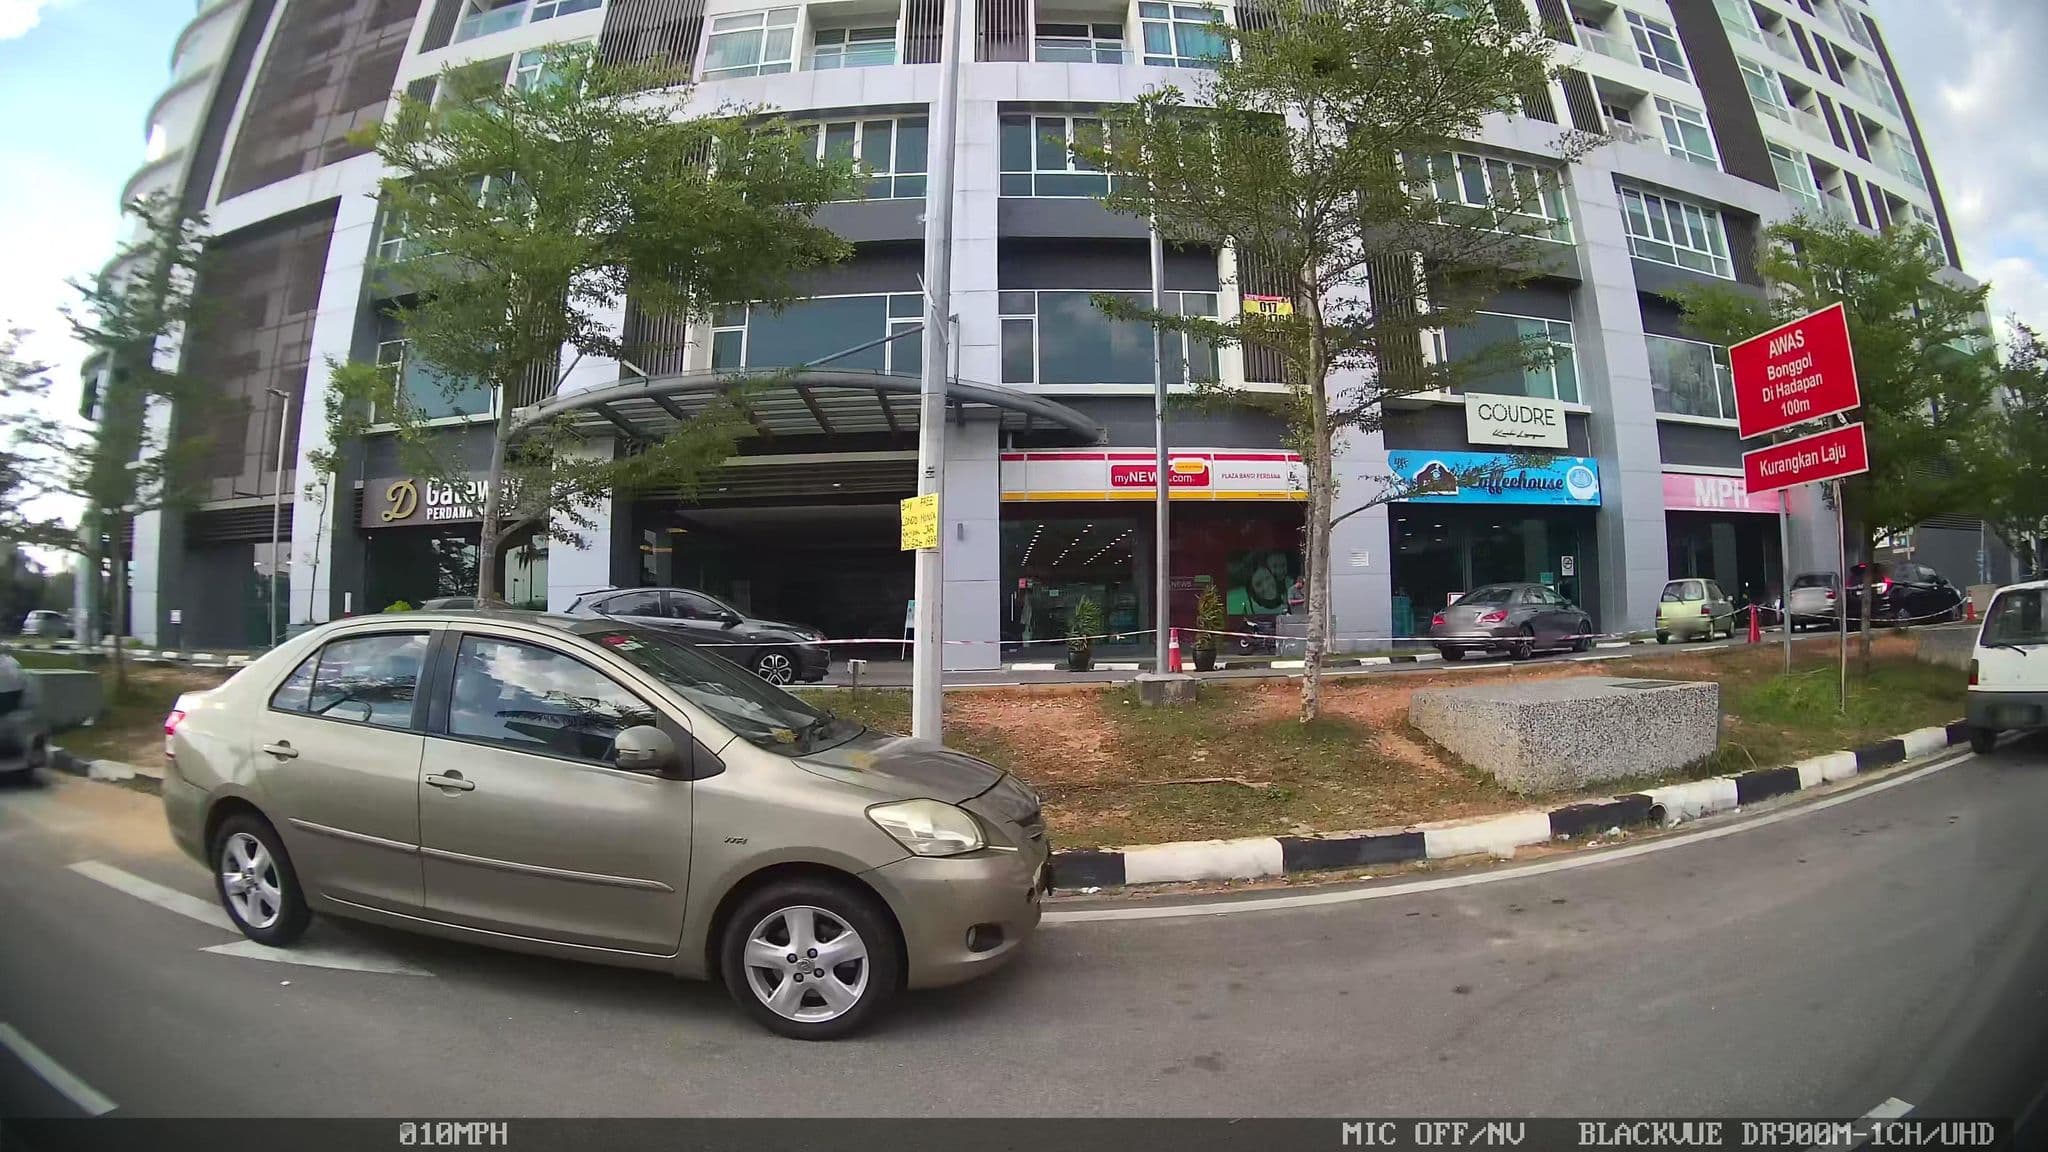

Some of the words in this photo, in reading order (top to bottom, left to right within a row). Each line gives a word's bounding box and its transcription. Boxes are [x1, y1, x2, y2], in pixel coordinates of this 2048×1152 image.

[1260, 301, 1278, 313] 017
[1769, 329, 1805, 359] AWAS
[1766, 351, 1813, 381] Bonggol
[1762, 385, 1774, 403] Di
[1775, 373, 1823, 399] Hadapan
[1478, 403, 1556, 426] COUDRE
[1781, 398, 1811, 417] 100m
[1760, 450, 1819, 477] Kurangkan
[1820, 442, 1846, 465] Laju
[1114, 472, 1193, 484] myNEW.com
